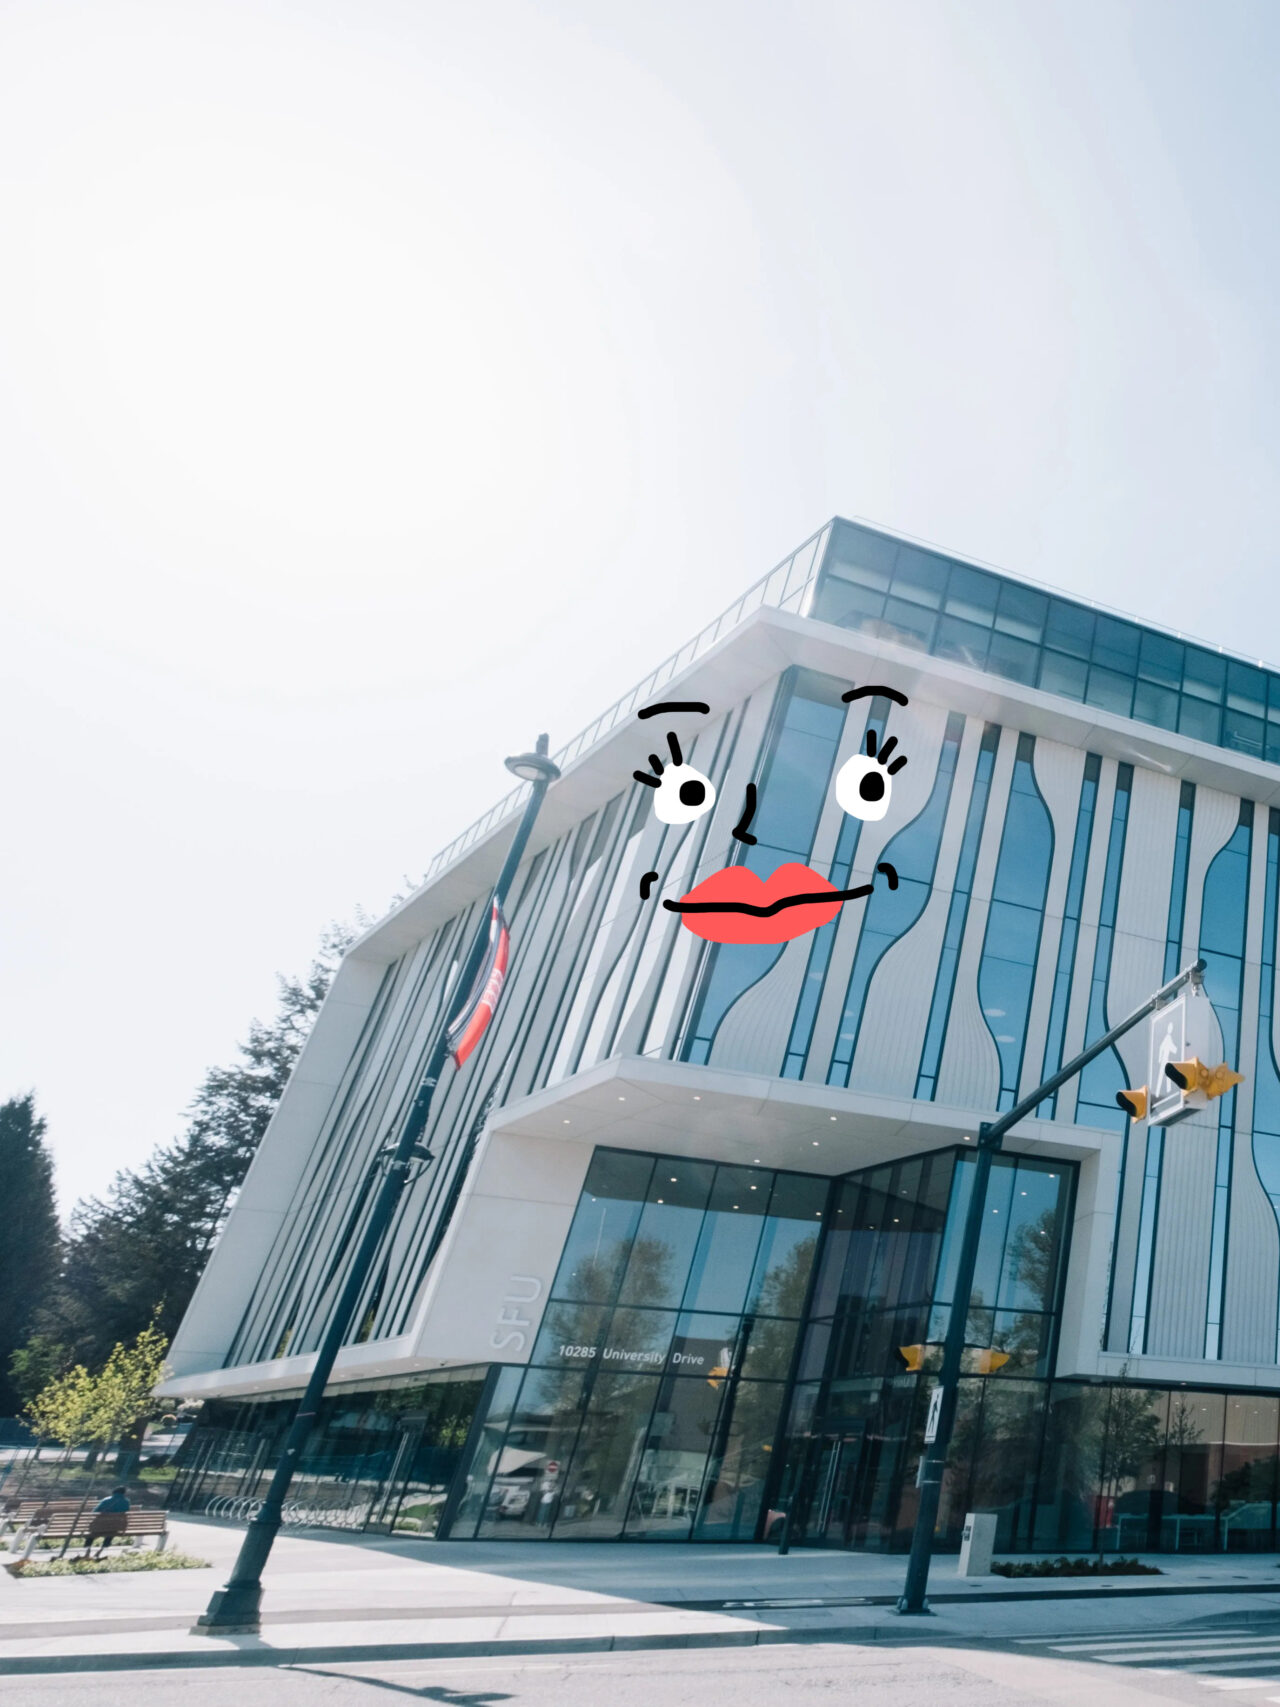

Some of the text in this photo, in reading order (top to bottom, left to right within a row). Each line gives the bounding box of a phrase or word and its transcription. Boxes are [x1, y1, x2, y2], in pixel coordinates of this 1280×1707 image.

[490, 1276, 541, 1351] SFU
[559, 1345, 705, 1365] 10285 University Drive
